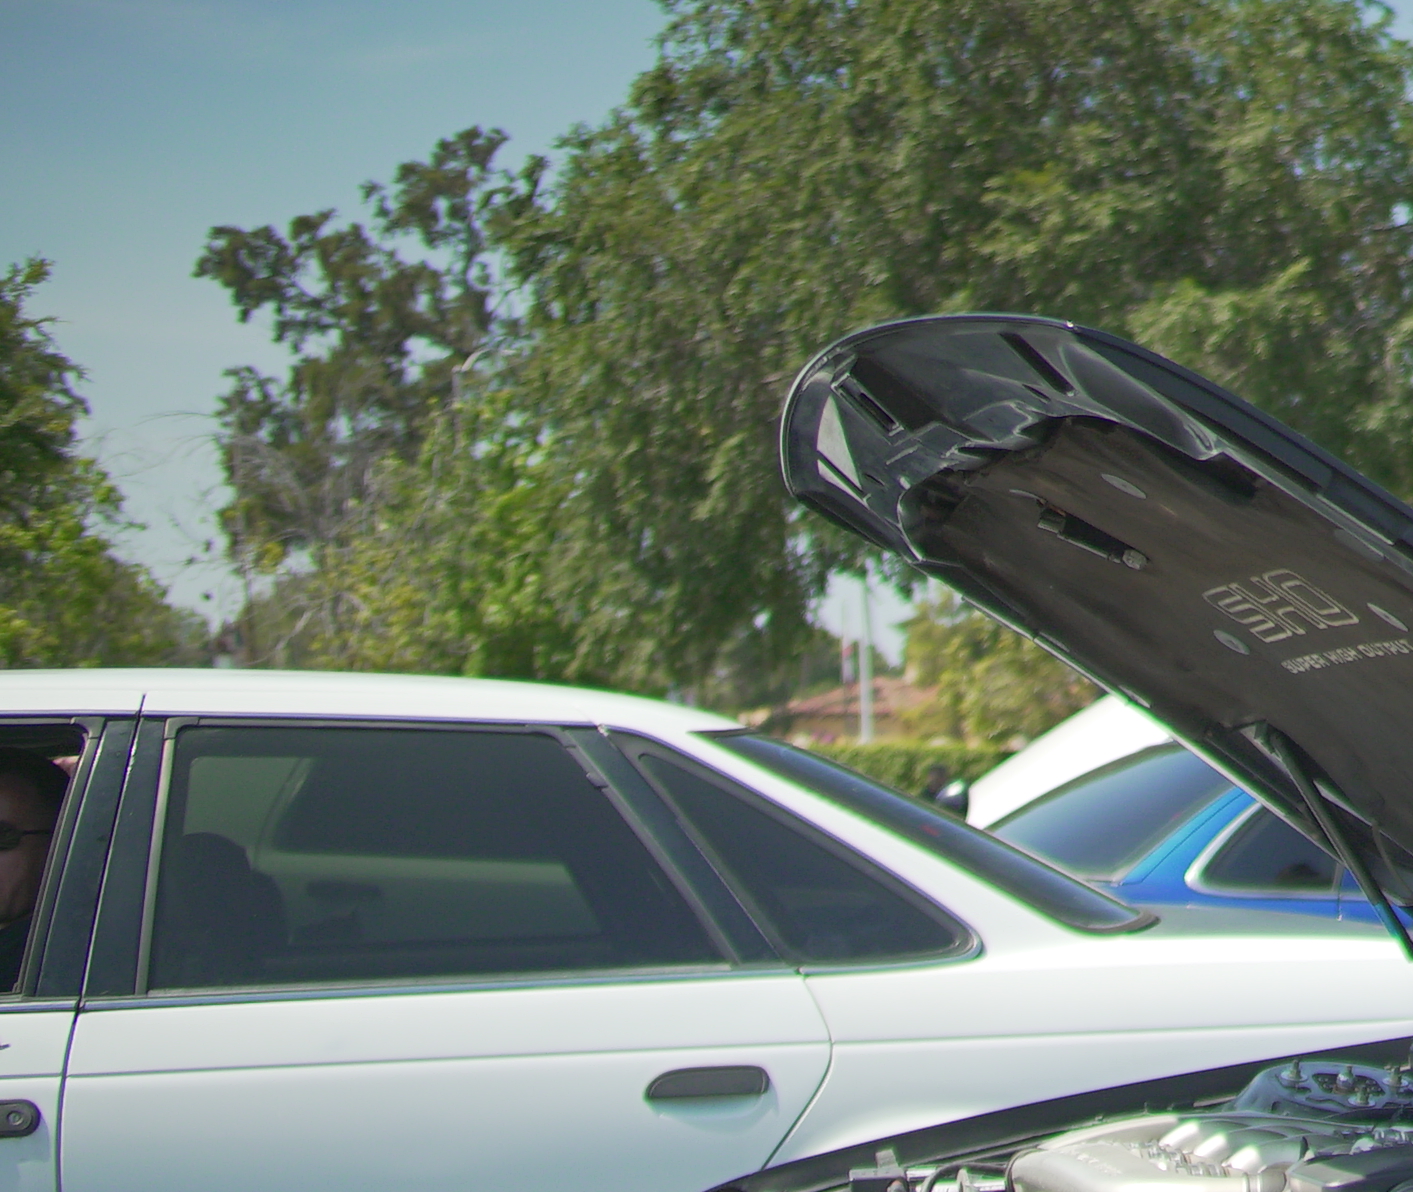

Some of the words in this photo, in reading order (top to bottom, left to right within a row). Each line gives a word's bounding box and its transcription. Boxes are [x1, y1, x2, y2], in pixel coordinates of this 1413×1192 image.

[1202, 568, 1360, 643] SHO
[1281, 653, 1330, 674] SUPER
[1323, 646, 1363, 665] HIGH
